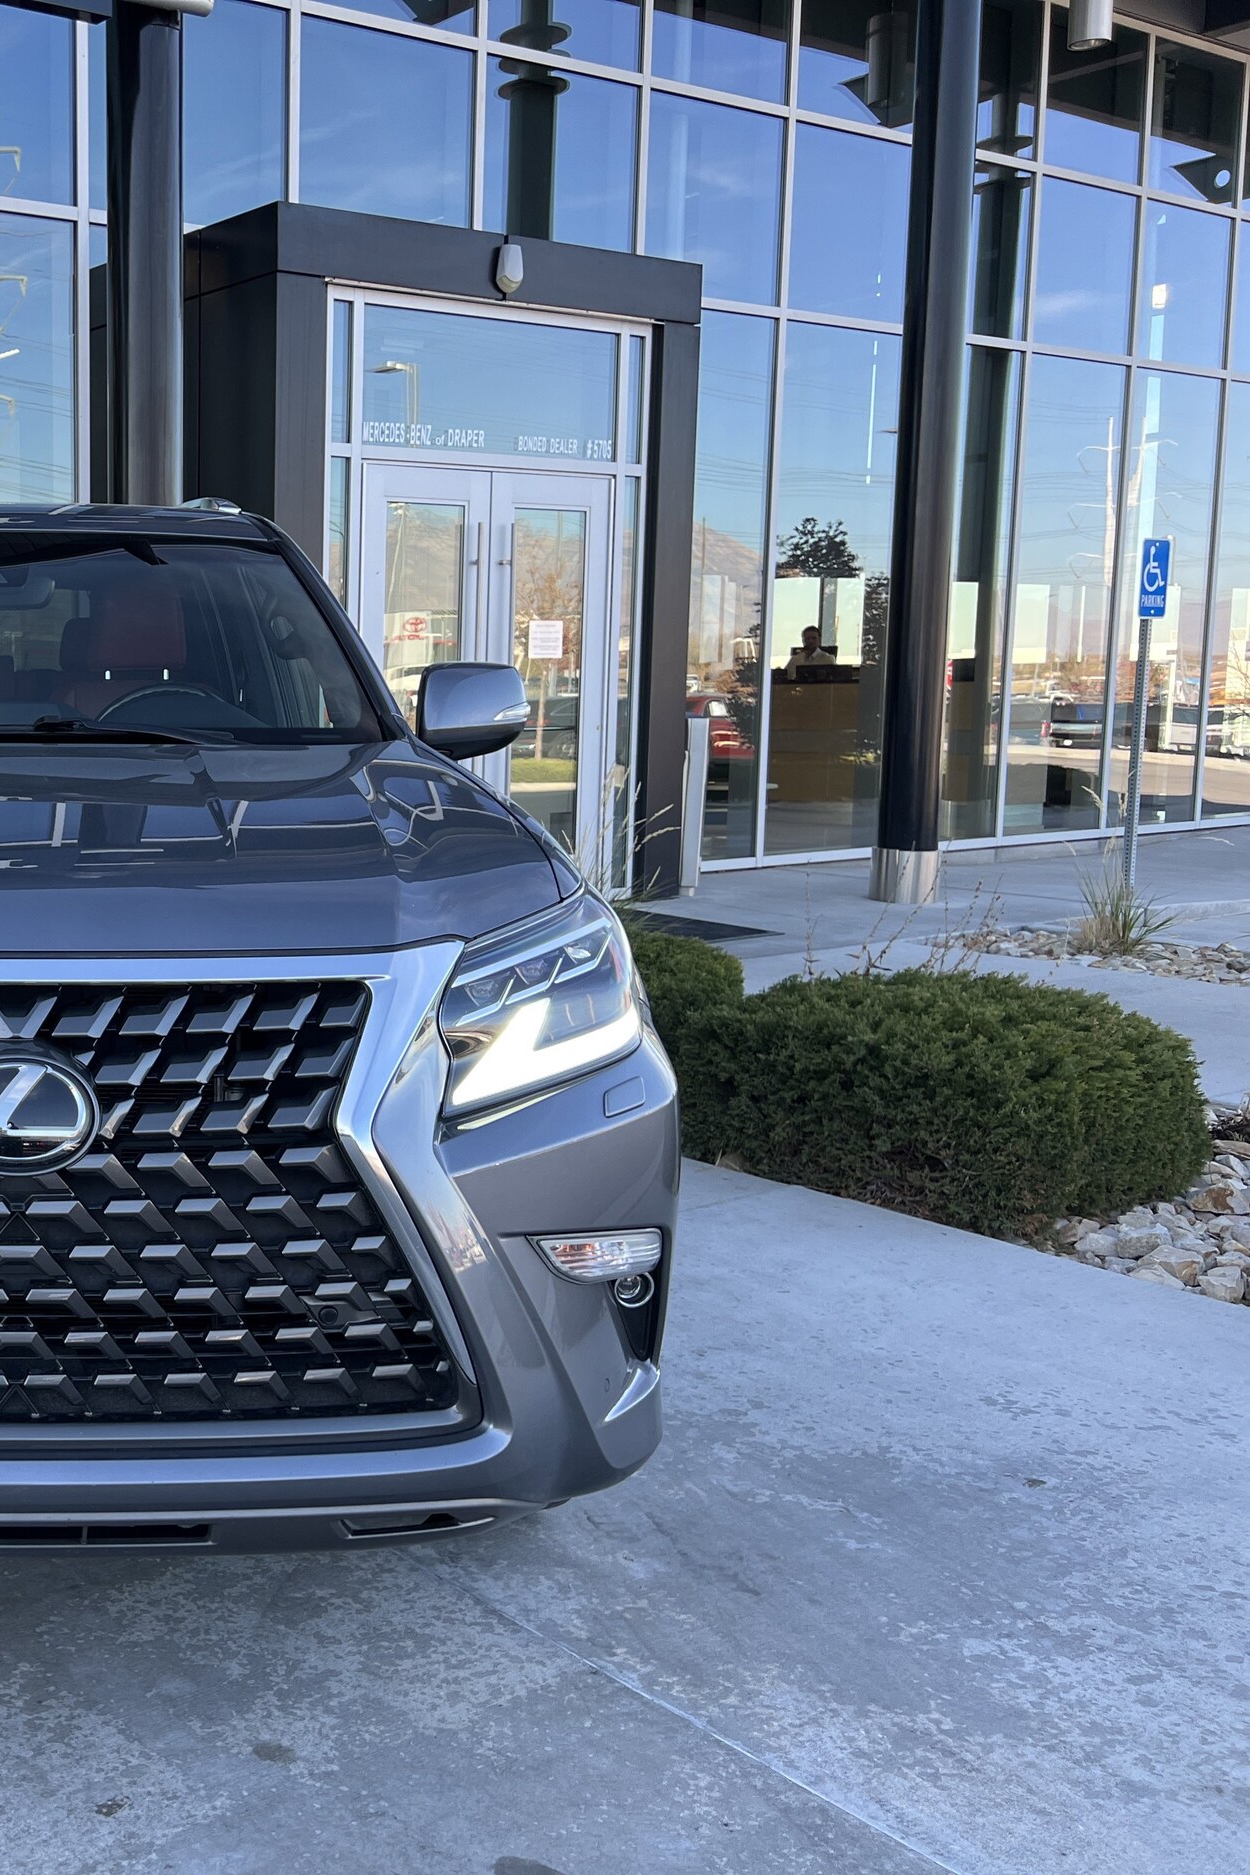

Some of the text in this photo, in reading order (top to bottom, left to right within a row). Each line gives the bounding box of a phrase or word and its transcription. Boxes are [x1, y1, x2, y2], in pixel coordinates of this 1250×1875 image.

[436, 434, 446, 446] of
[447, 429, 485, 447] DRAPER
[518, 436, 547, 452] BONDED
[550, 438, 578, 454] DEALER
[1141, 594, 1165, 608] PARKING
